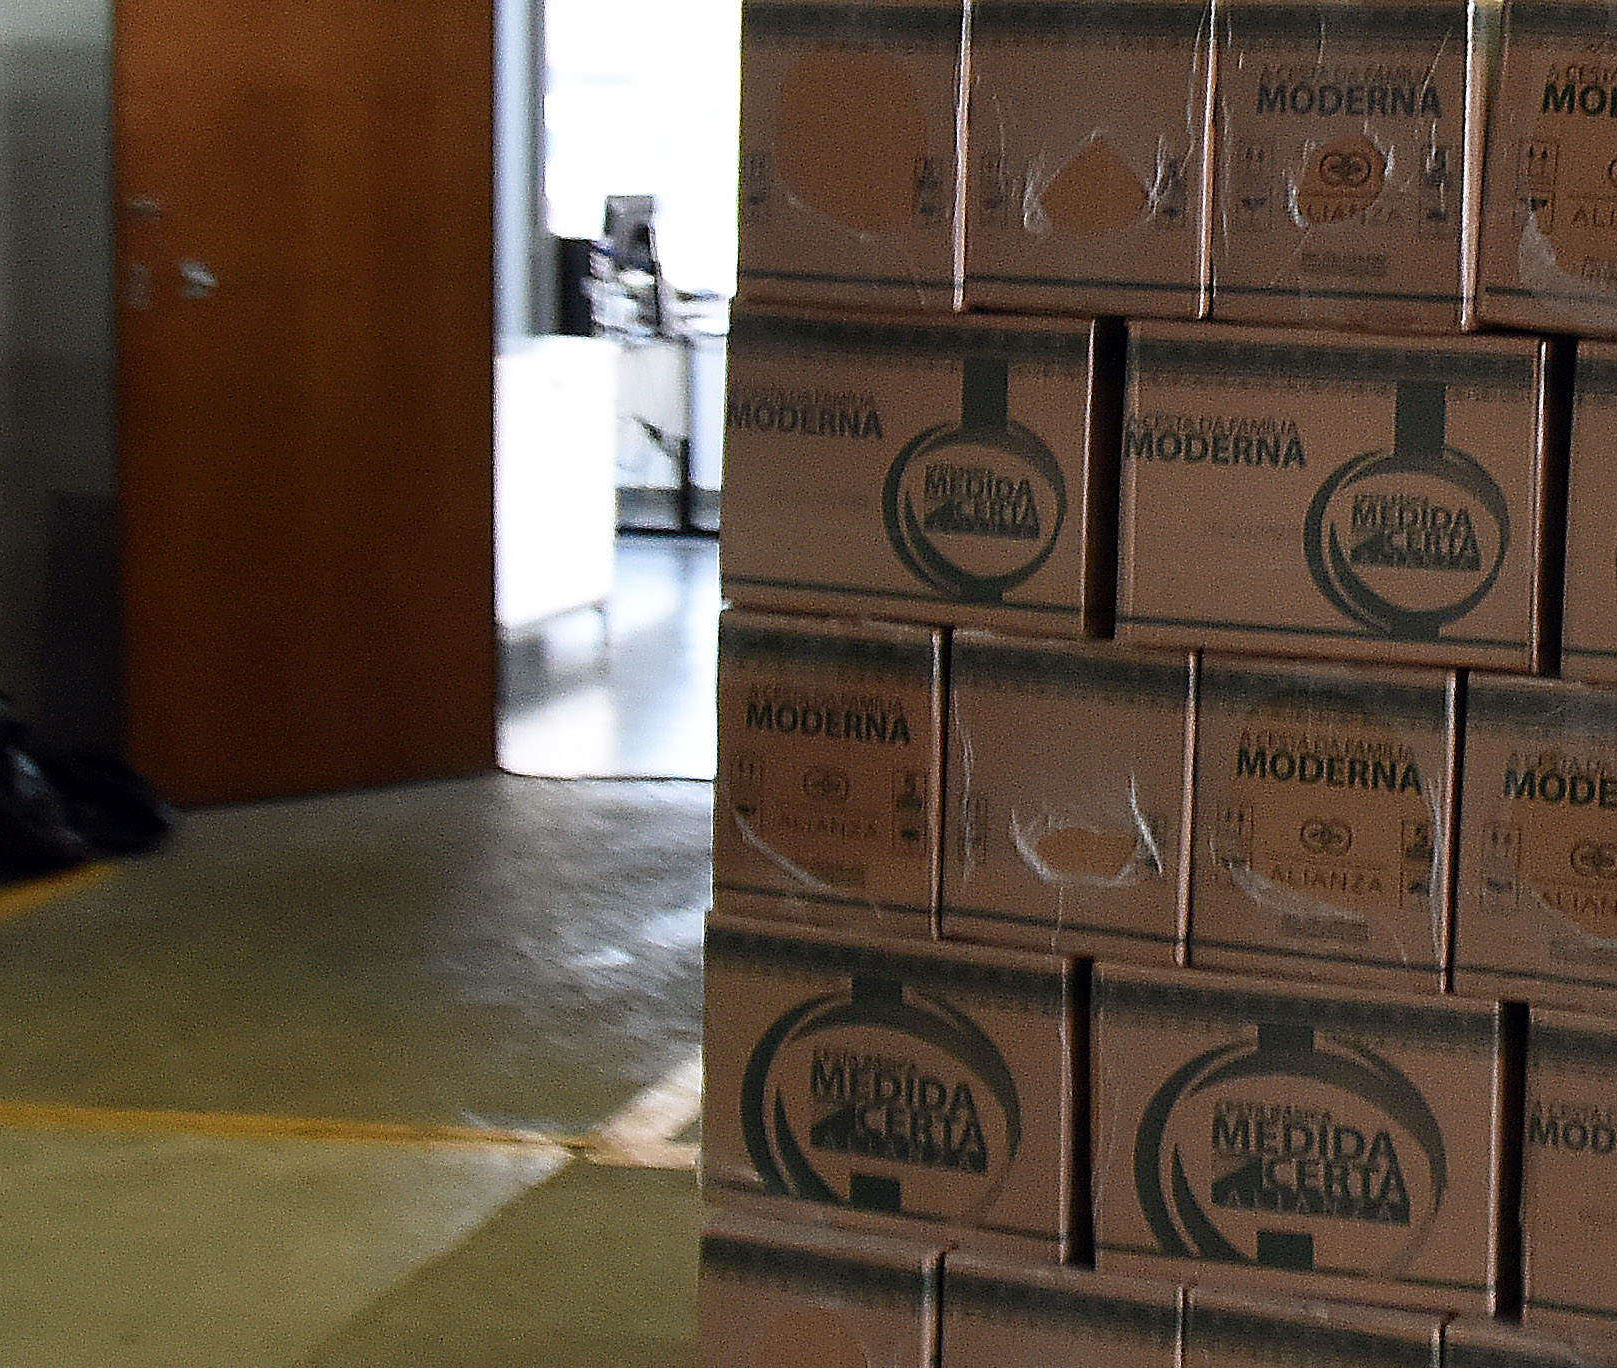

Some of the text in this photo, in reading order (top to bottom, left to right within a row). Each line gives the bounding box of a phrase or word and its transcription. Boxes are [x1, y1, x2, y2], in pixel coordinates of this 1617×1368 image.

[1256, 83, 1443, 119] MODERNA
[1125, 429, 1306, 469] MODERNA
[1352, 504, 1471, 537] MEDIDA
[746, 701, 911, 744] MODERNA
[1237, 747, 1423, 795] MODERNA
[1269, 865, 1384, 895] ALIANZA
[812, 1059, 976, 1117] MEDIDA
[857, 1103, 986, 1152] CERTA
[1212, 1116, 1396, 1170] MEDIDA
[1264, 1158, 1409, 1205] CERTA
